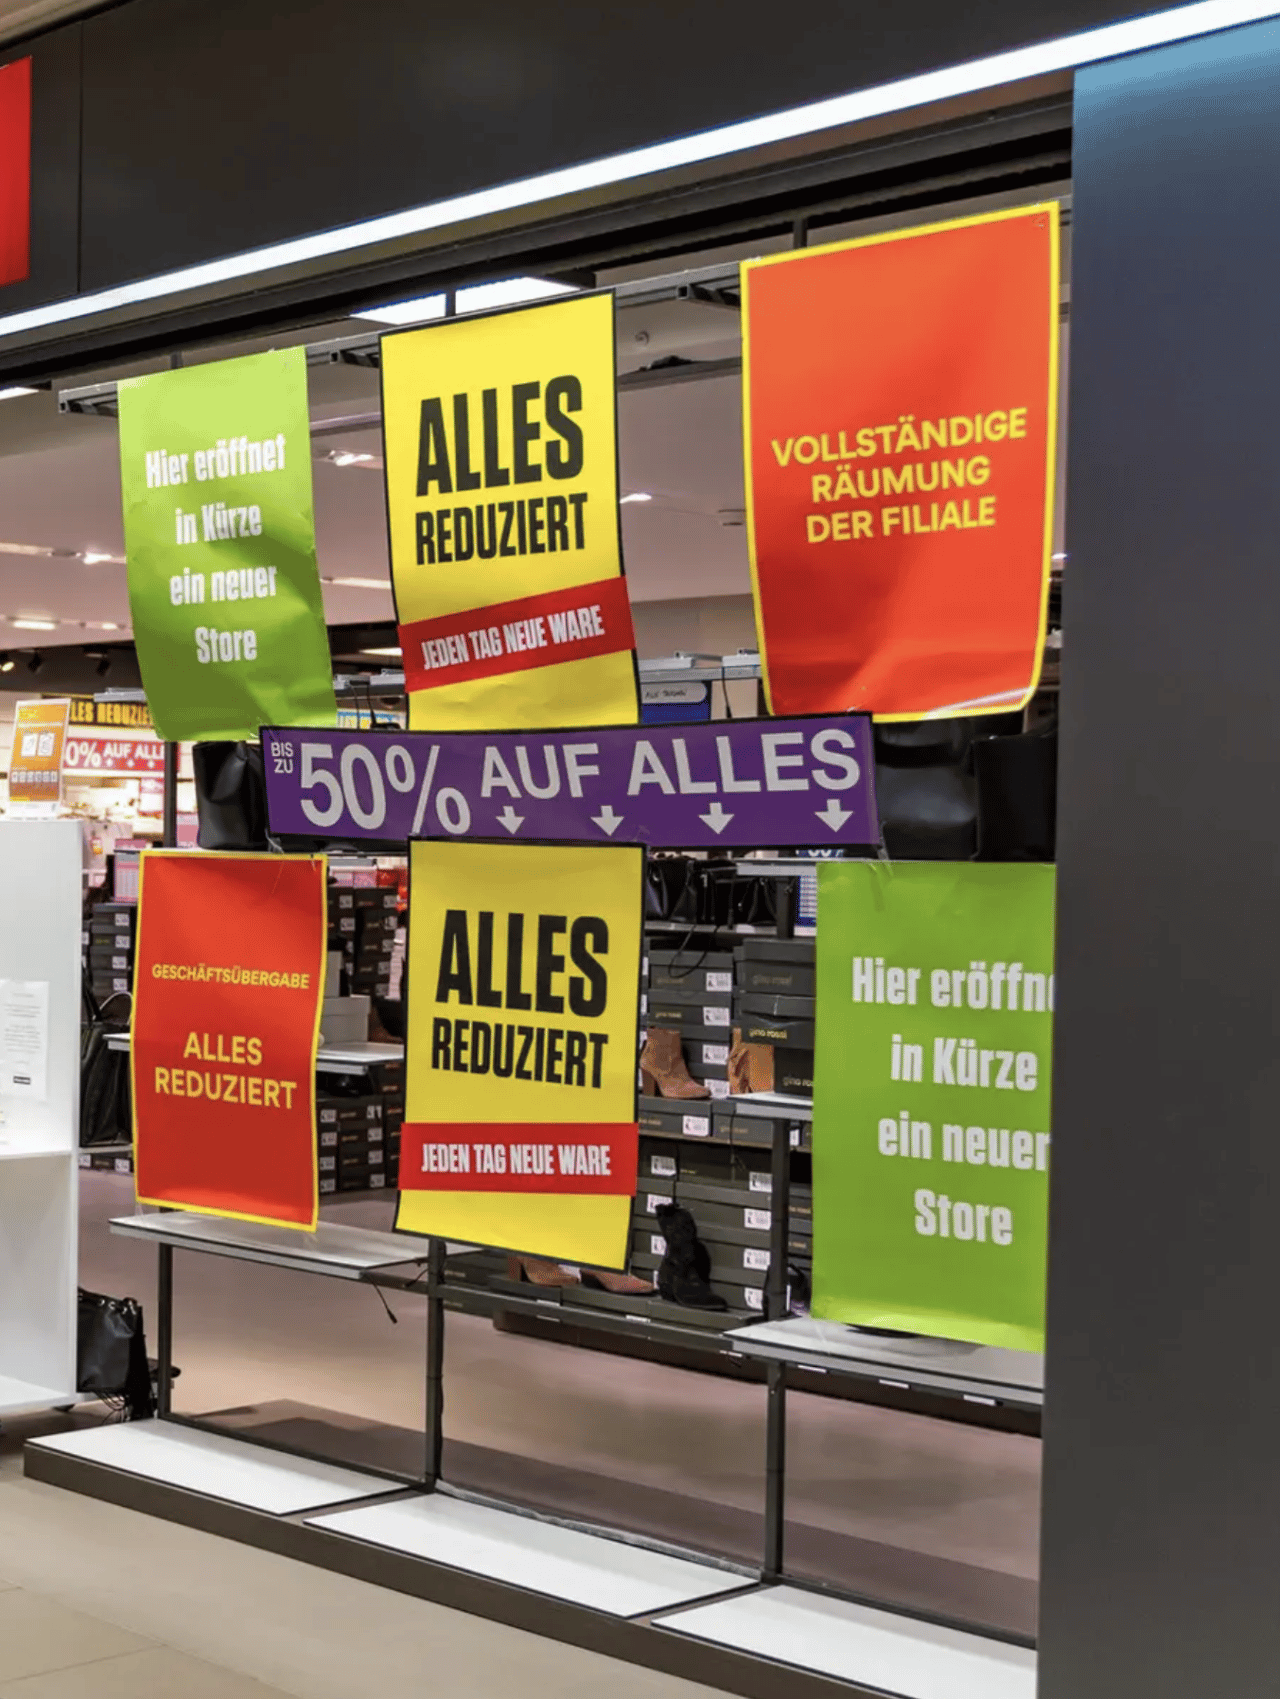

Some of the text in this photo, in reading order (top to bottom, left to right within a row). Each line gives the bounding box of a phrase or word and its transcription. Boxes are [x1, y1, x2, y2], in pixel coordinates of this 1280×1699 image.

[416, 374, 584, 498] ALLES
[771, 406, 1028, 467] VOLLSTÄNDIGE
[145, 433, 286, 488] Hier eröffnet
[811, 455, 991, 503] RÄUMUNG
[175, 501, 262, 545] in Kürze
[415, 492, 588, 566] REDUZIERT
[806, 495, 996, 543] DER FILIALE
[170, 566, 277, 606] ein neuer
[195, 626, 257, 664] Store
[421, 604, 606, 670] JEDEN TAG NEUE WARE
[103, 743, 131, 758] AUF
[270, 742, 294, 757] BIS
[273, 759, 293, 774] ZU
[300, 728, 861, 835] 50% AUF ALLES
[152, 963, 310, 989] GESCHÄFTSÜBERGABE
[434, 909, 609, 1018] ALLES
[852, 956, 920, 1005] Hier
[183, 1031, 263, 1066] ALLES
[431, 1016, 609, 1089] REDUZIERT
[891, 1033, 1038, 1091] in Kürze
[155, 1066, 297, 1109] REDUZIERT
[421, 1143, 612, 1176] JEDEN TAG NEUE WARE
[878, 1111, 1050, 1171] ein neuer
[914, 1188, 1013, 1246] Store
